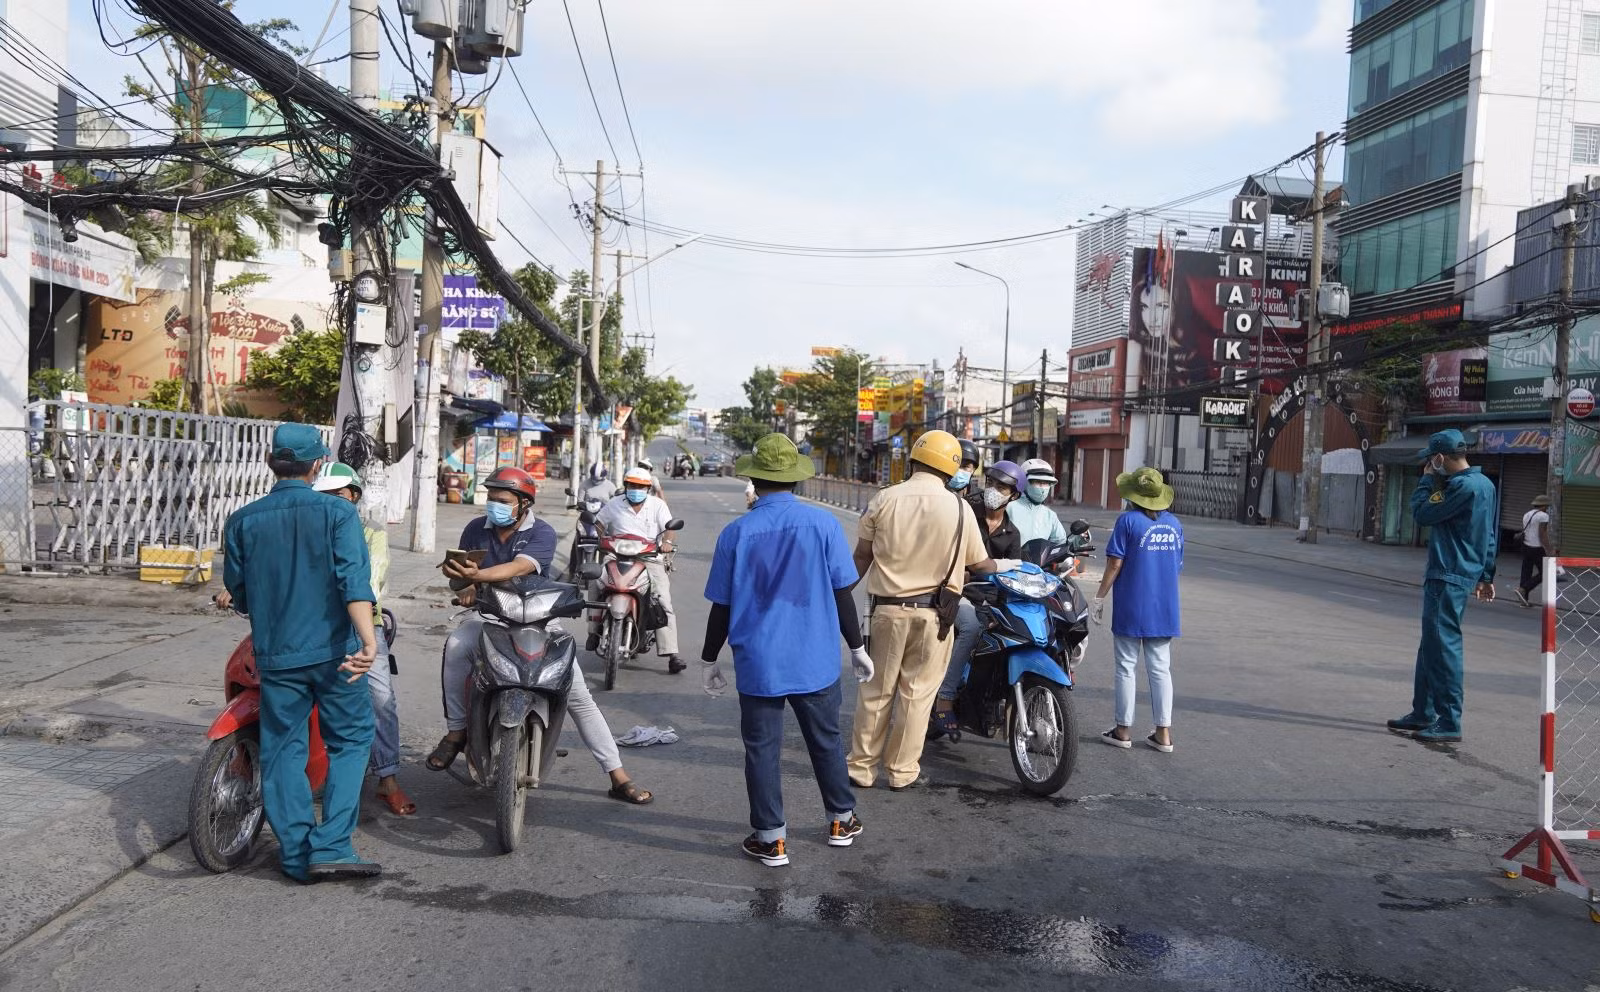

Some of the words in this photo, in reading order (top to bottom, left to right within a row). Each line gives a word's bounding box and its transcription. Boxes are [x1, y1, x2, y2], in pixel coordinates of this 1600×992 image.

[1271, 268, 1307, 282] KINH
[1226, 201, 1256, 388] KARAOKE
[228, 326, 257, 341] 2021
[1205, 401, 1245, 416] KARAOKE
[1150, 533, 1174, 543] 2020
